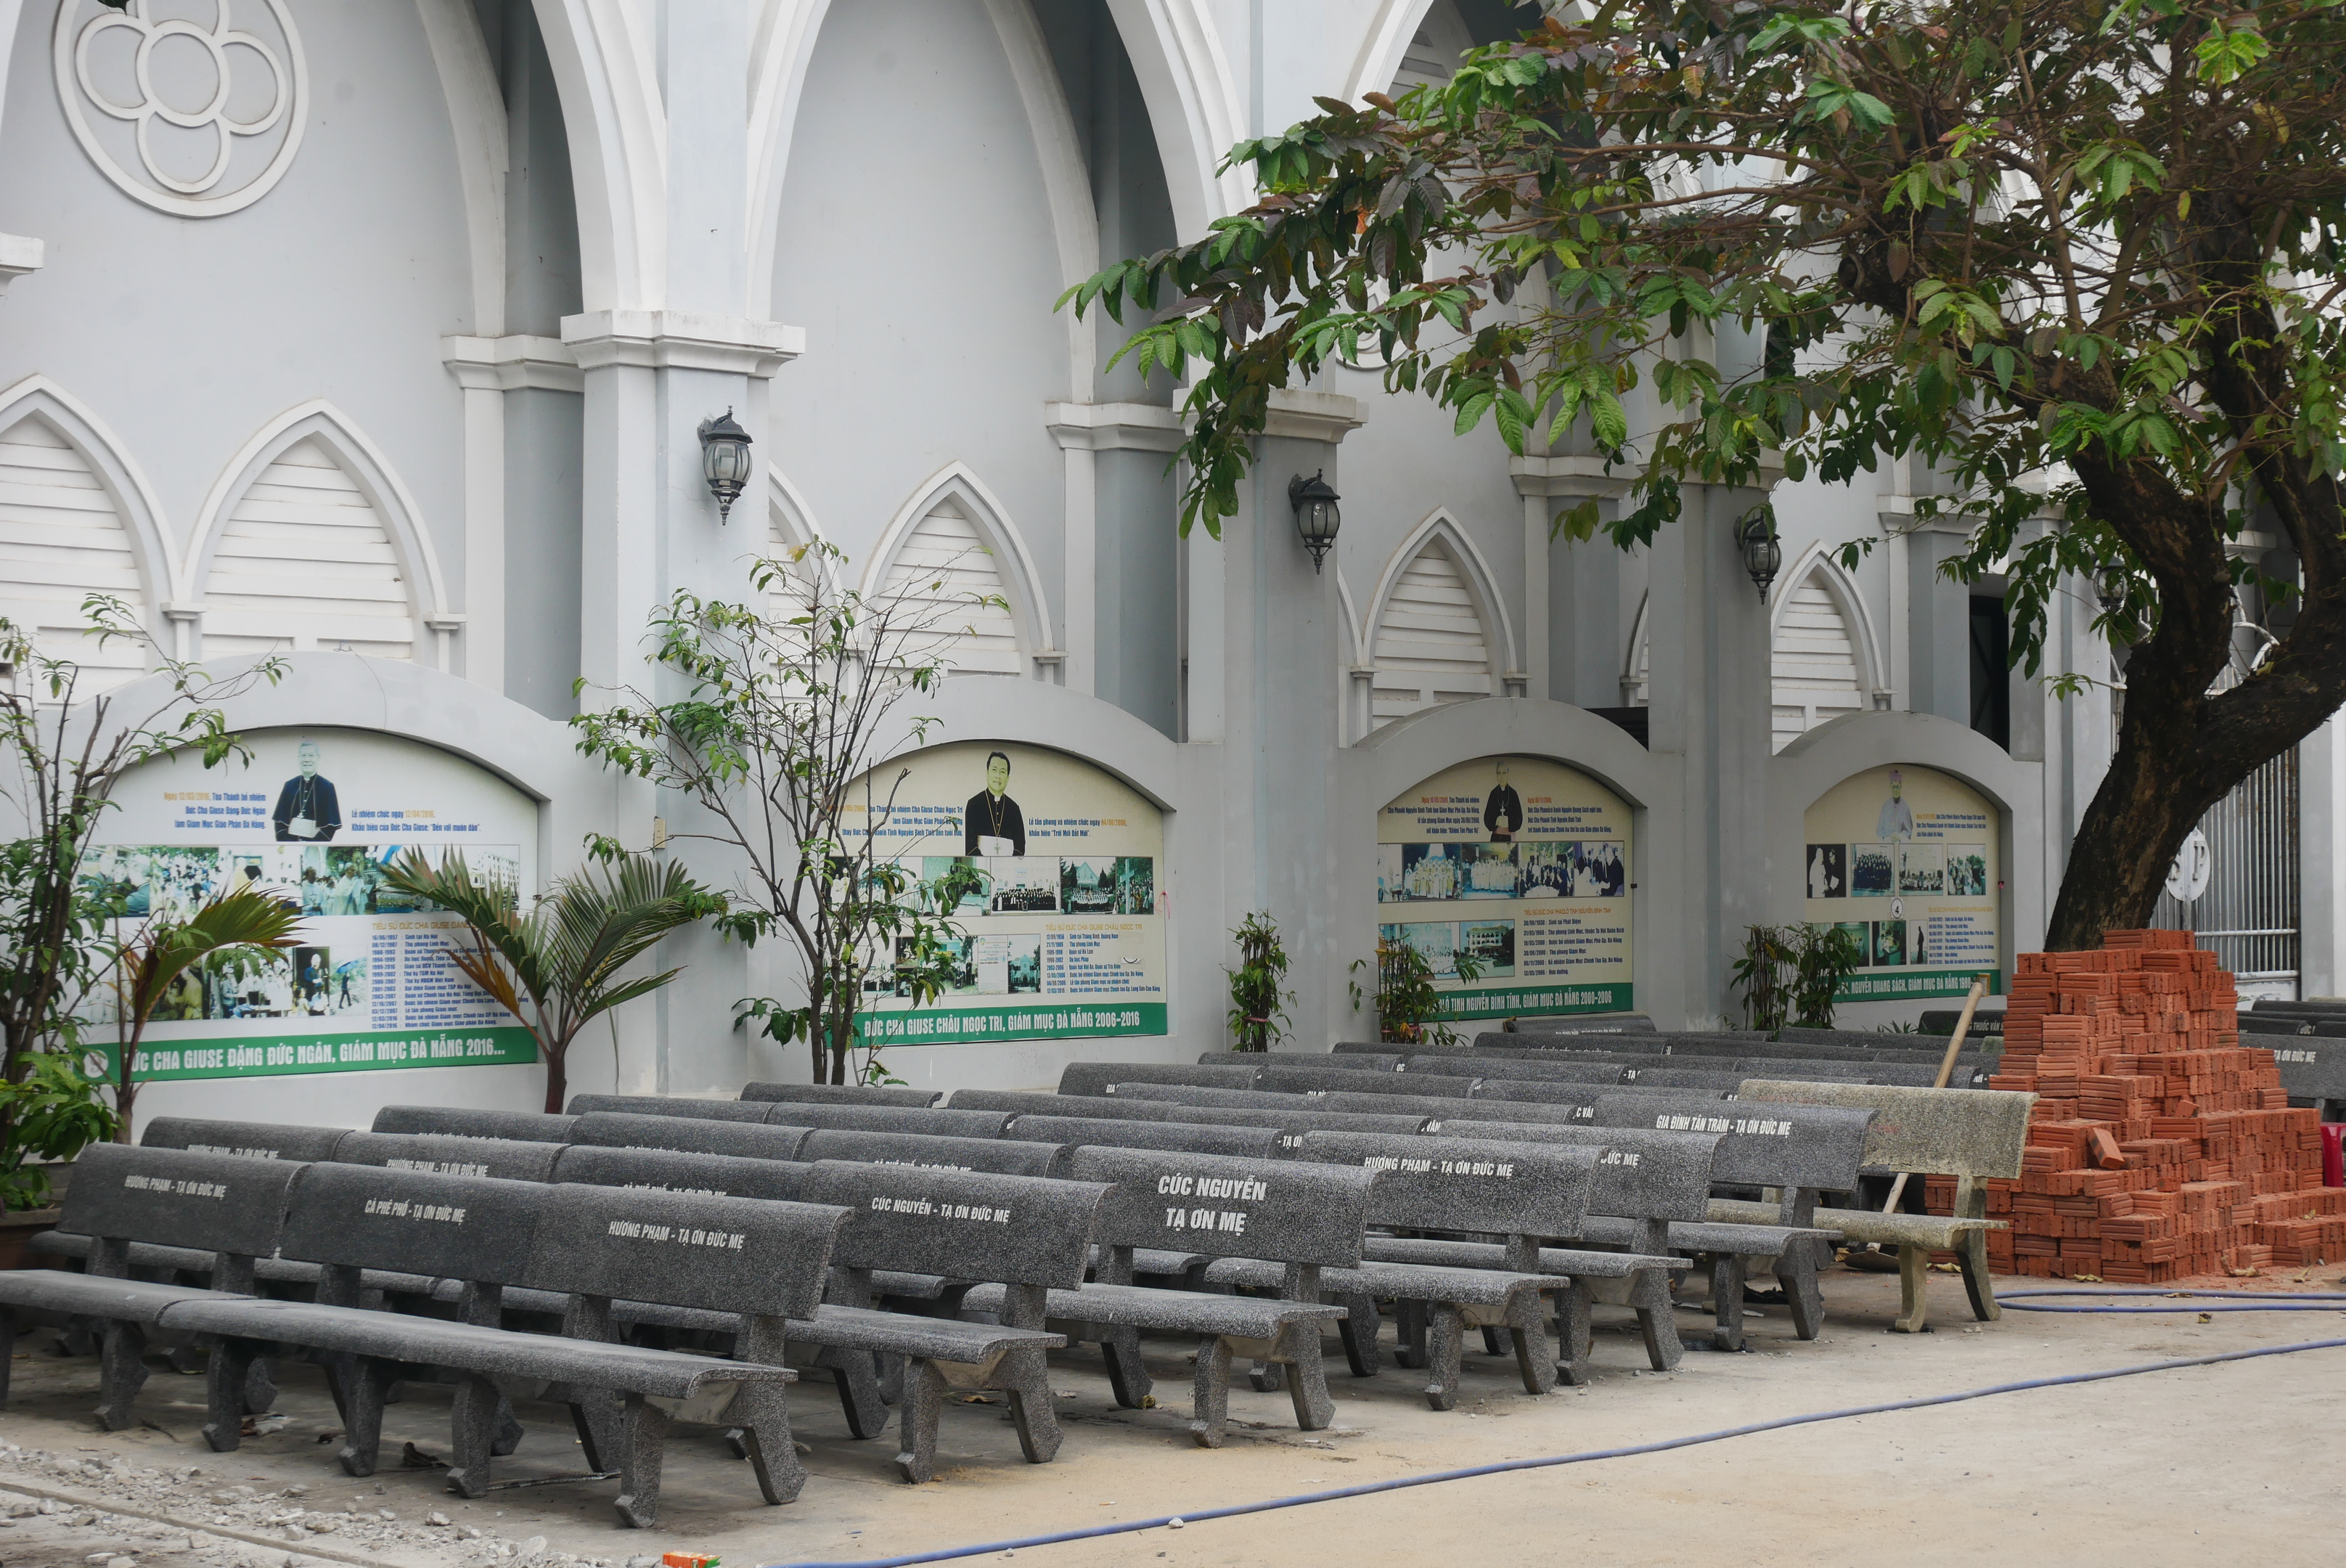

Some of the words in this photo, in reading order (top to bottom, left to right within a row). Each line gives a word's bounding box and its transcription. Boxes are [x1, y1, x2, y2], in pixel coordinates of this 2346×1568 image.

[1851, 976, 1872, 994] NGUYỄN
[1873, 979, 1890, 993] QUANG
[1908, 976, 1922, 991] GIÁM
[1923, 977, 1936, 992] MỤC
[1937, 975, 1944, 990] ĐÀ
[1945, 973, 1958, 989] NẴNG
[1466, 992, 1489, 1011] NGUYỄN
[1490, 993, 1505, 1010] BÌNH
[1523, 992, 1539, 1008] GIÁM
[1540, 992, 1553, 1010] MỤC
[1555, 989, 1563, 1006] ĐÀ
[1564, 987, 1579, 1005] NẴNG
[864, 1017, 883, 1037] ĐỨC
[886, 1019, 904, 1036] CHA
[907, 1018, 933, 1035] GIUSE
[936, 1014, 960, 1034] CHÂU
[962, 1016, 986, 1035] NGỌC
[989, 1015, 1005, 1032] TRI,
[1008, 1012, 1031, 1031] GIÁM
[1034, 1013, 1054, 1032] MỤC
[1056, 1010, 1068, 1029] ĐÀ
[1070, 1007, 1093, 1028] NẴNG
[125, 1048, 149, 1071] ỨC
[153, 1050, 180, 1071] CHA
[184, 1049, 224, 1069] GIUSE
[227, 1045, 263, 1070] ĐẶNG
[266, 1042, 293, 1066] ĐỨC
[298, 1041, 336, 1063] NGÂN,
[340, 1040, 374, 1062] GIÁM
[377, 1041, 406, 1063] MỤC
[410, 1037, 427, 1058] ĐÀ
[430, 1034, 463, 1058] NẴNG
[2305, 1051, 2317, 1065] MẸ
[1656, 1115, 1669, 1129] GIA
[1669, 1113, 1691, 1130] ĐÌNH
[1691, 1114, 1707, 1132] TÂN
[1707, 1115, 1730, 1132] TRÂM
[1736, 1119, 1746, 1136] TẠ
[1747, 1118, 1760, 1134] ƠN
[1759, 1118, 1778, 1135] ĐỨC
[1778, 1121, 1792, 1138] MẸ
[450, 1162, 461, 1175] ƠN
[461, 1161, 475, 1176] ĐỨC
[1365, 1156, 1398, 1170] HƯƠNG
[1401, 1158, 1431, 1174] PHẠM
[1442, 1161, 1452, 1176] TẠ
[1455, 1160, 1470, 1175] ƠN
[1473, 1160, 1494, 1175] ĐỨC
[1497, 1164, 1514, 1179] MẸ
[1623, 1153, 1640, 1168] MẸ
[150, 1177, 171, 1193] PHẠM
[176, 1181, 186, 1196] TẠ
[186, 1180, 197, 1194] ƠN
[197, 1180, 213, 1196] ĐỨC
[213, 1185, 227, 1200] MẸ
[1158, 1172, 1193, 1195] CÚC
[1196, 1175, 1267, 1201] NGUYỄN
[376, 1199, 393, 1214] PHÊ
[391, 1199, 410, 1217] PHỐ
[413, 1204, 423, 1221] TẠ
[423, 1204, 435, 1219] ƠN
[435, 1205, 452, 1221] ĐỨC
[451, 1208, 466, 1226] MẸ
[872, 1195, 892, 1211] CÚC
[894, 1197, 932, 1215] NGUYỄN
[941, 1204, 952, 1220] TẠ
[955, 1204, 970, 1219] ƠN
[970, 1204, 992, 1221] ĐỨC
[994, 1209, 1010, 1225] MẸ
[1166, 1208, 1185, 1231] TẠ
[1190, 1208, 1216, 1230] ƠN
[1219, 1212, 1247, 1236] MẸ
[608, 1220, 641, 1238] HƯƠNG
[641, 1225, 670, 1243] PHẠM
[678, 1228, 690, 1246] TẠ
[691, 1228, 706, 1244] ƠN
[706, 1229, 727, 1247] ĐỨC
[728, 1234, 745, 1252] MẸ
